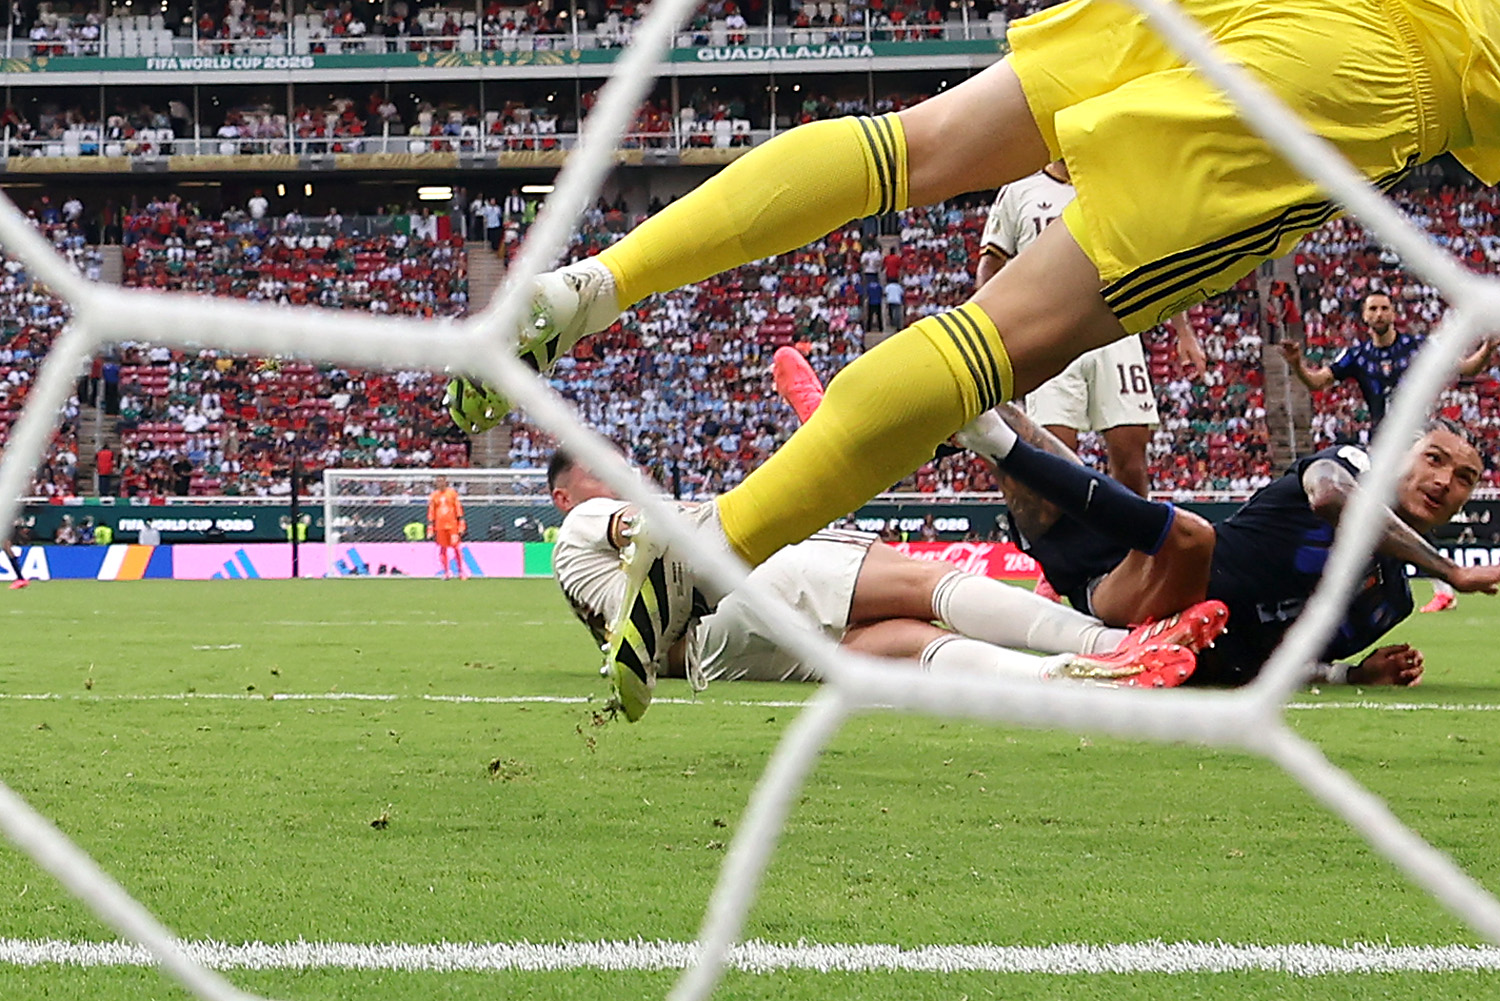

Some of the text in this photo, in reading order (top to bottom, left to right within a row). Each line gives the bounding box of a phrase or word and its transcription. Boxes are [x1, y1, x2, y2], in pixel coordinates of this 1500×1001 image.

[698, 44, 876, 62] GUADALAJARA
[146, 56, 315, 70] FIFA WORLD CUP 2026
[1116, 363, 1148, 395] 16
